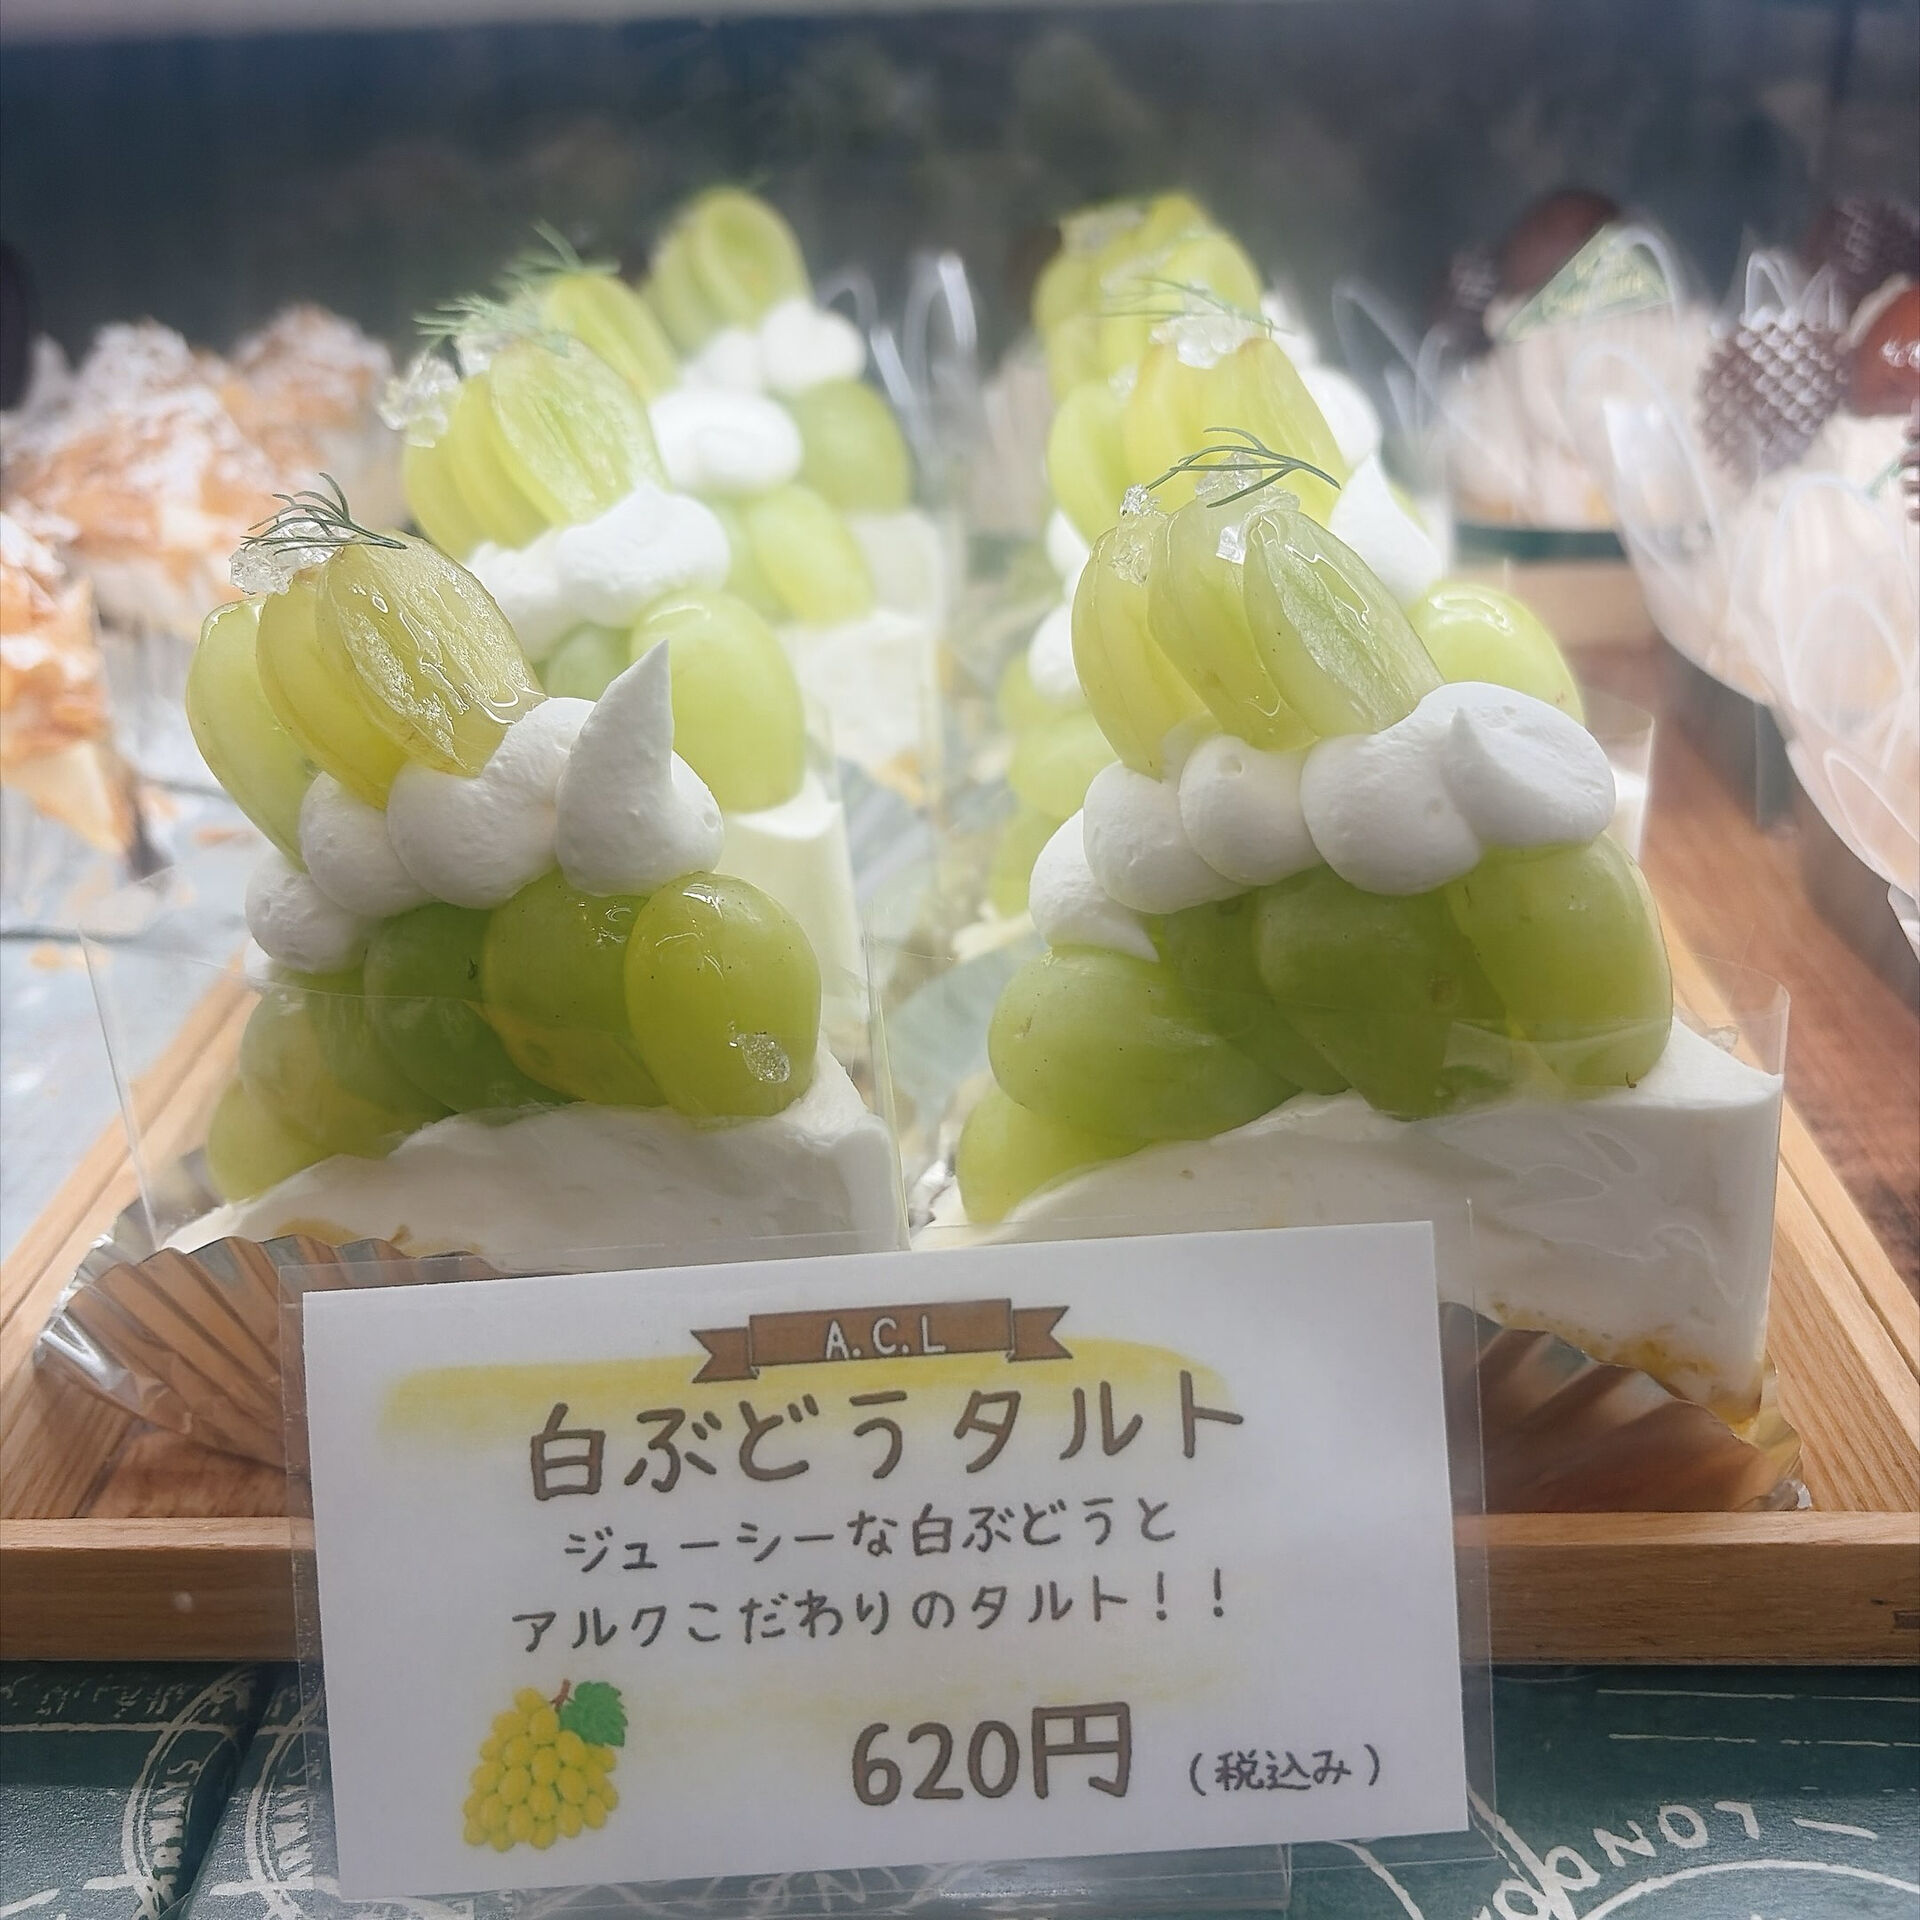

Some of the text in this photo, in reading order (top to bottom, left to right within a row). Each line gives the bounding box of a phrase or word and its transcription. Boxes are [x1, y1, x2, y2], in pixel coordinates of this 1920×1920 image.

[825, 1314, 946, 1361] A.C.L
[529, 1369, 1245, 1502] 白ぶどうタルト
[563, 1496, 1177, 1574] ジューシーな白ぶどうと
[851, 1701, 1133, 1806] 620円
